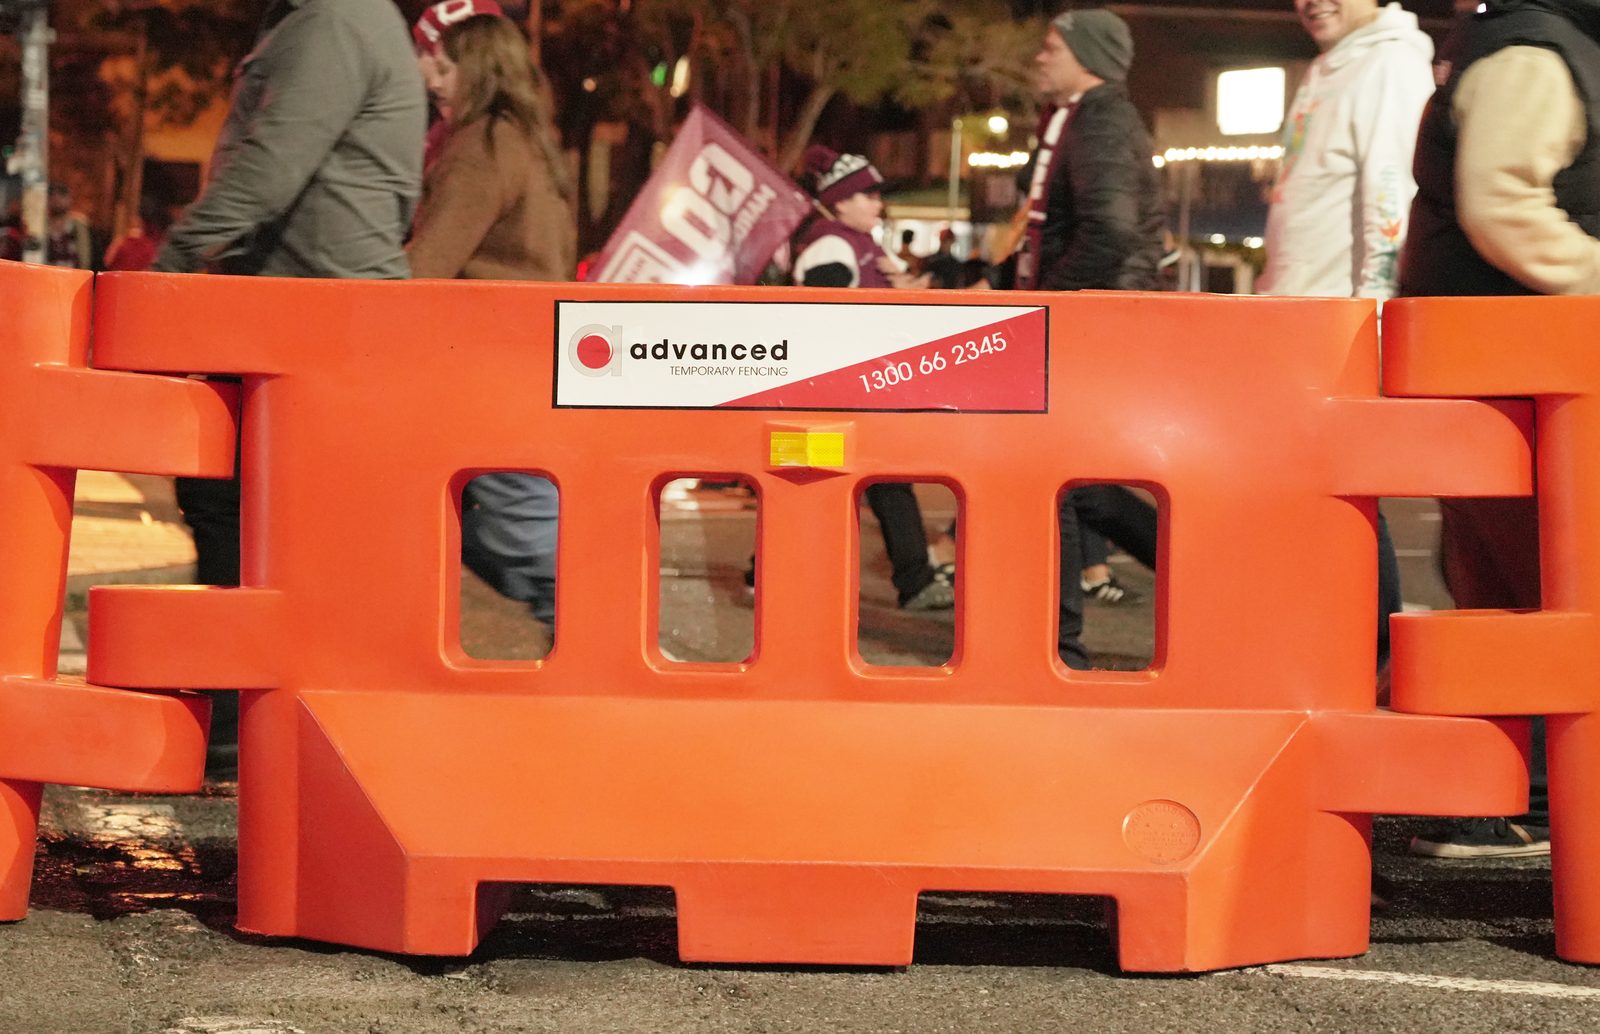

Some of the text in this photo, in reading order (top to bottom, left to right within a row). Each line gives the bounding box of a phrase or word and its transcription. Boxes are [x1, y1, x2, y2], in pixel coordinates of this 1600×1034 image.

[629, 338, 788, 361] advanced
[669, 365, 789, 377] TEMPORARY FENCING
[858, 331, 1007, 393] 1300 66 2345
